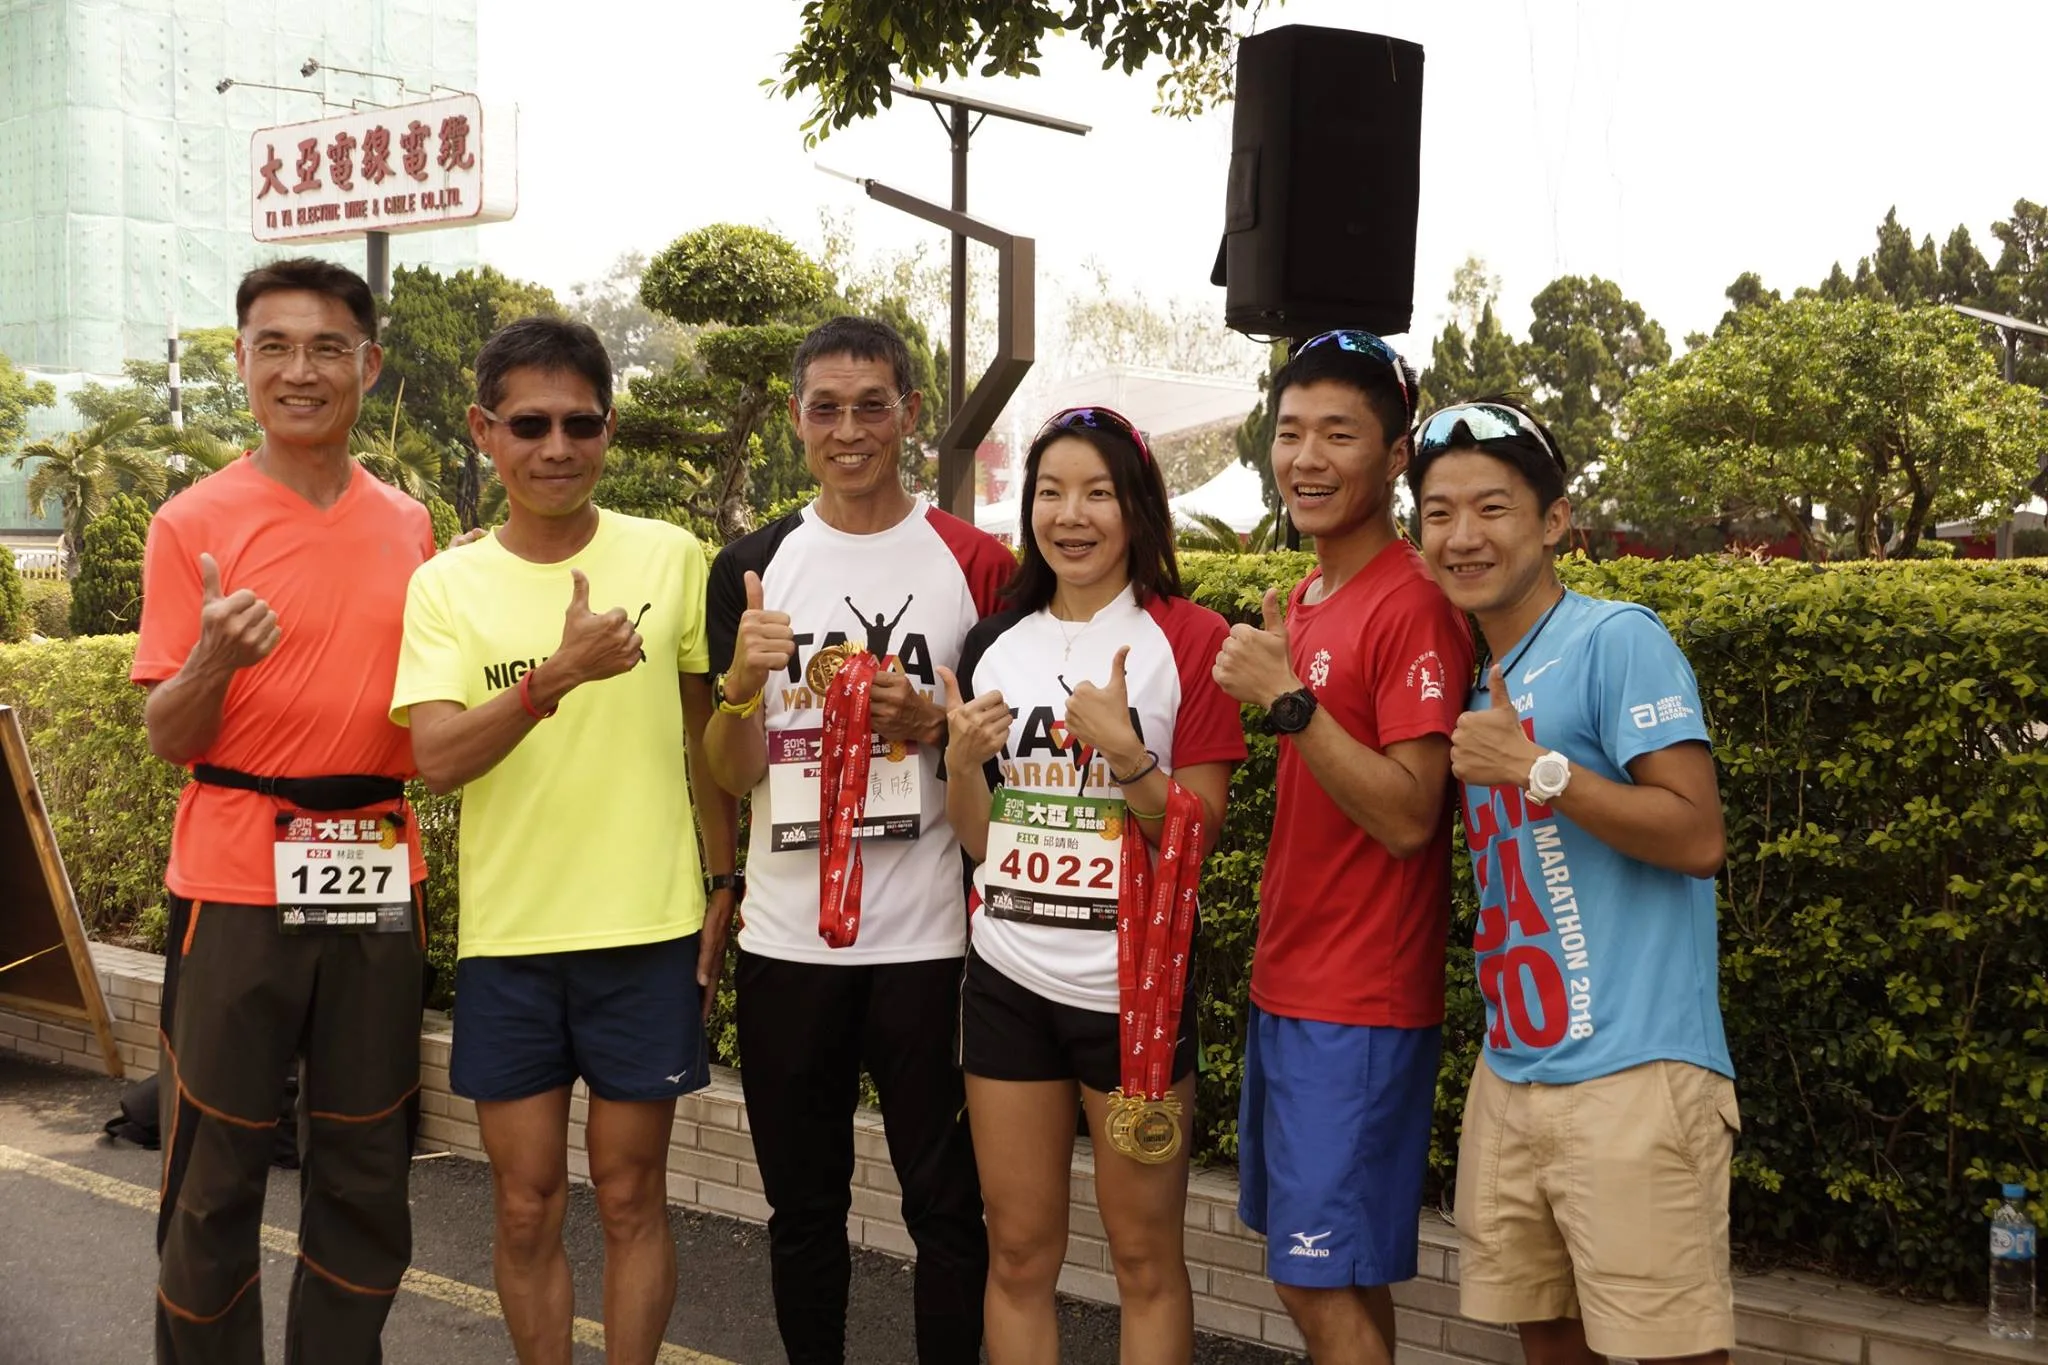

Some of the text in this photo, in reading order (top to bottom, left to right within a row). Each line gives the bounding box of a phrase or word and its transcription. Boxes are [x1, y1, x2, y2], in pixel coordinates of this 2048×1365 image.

[257, 114, 475, 200] 大亞電線電纜
[297, 204, 341, 225] ELECTRIC
[344, 199, 368, 219] WIRE
[383, 193, 416, 214] CABLE
[784, 738, 806, 749] 2019
[784, 748, 806, 757] 3/31
[1005, 798, 1025, 810] 2019
[1003, 807, 1024, 819] 3/31
[1026, 802, 1071, 828] 大亞
[1018, 834, 1037, 845] 21K
[308, 851, 330, 859] 42K
[1000, 849, 1114, 889] 4022
[291, 865, 393, 895] 1227
[1533, 824, 1594, 1040] MARATHON 2018
[1288, 1245, 1330, 1257] MIZUNO
